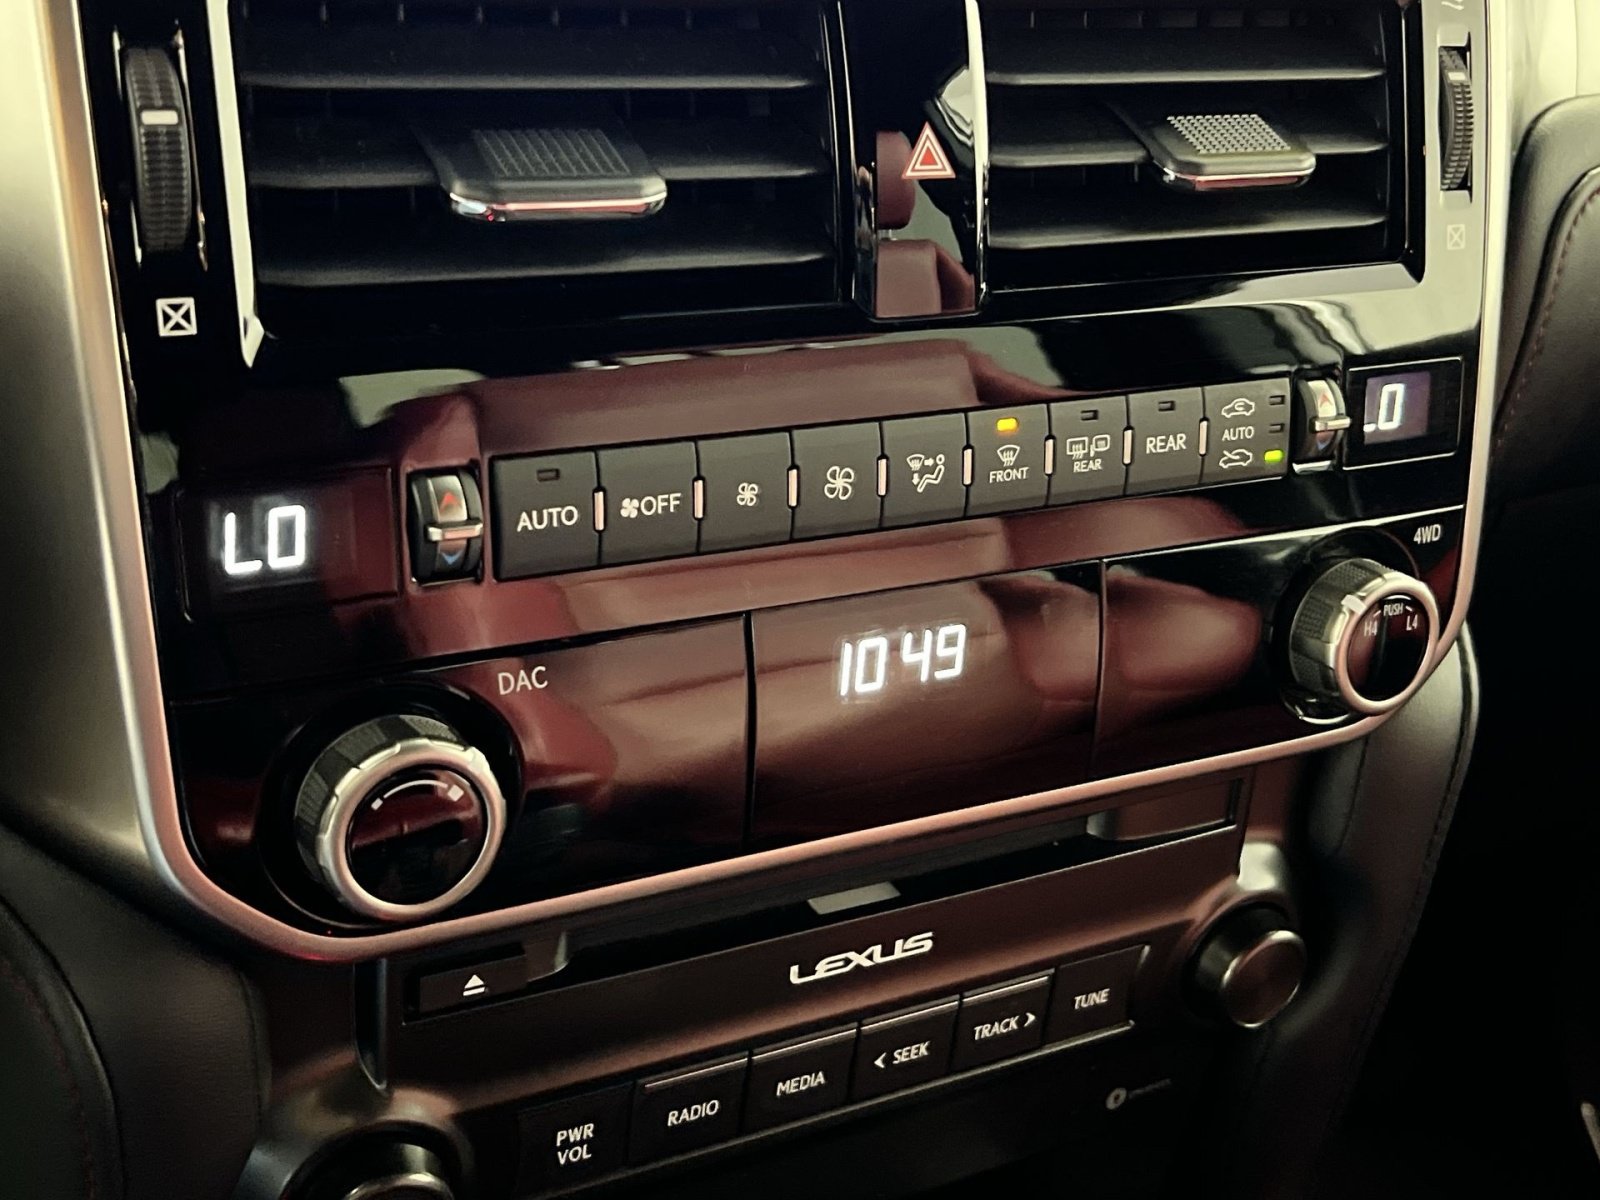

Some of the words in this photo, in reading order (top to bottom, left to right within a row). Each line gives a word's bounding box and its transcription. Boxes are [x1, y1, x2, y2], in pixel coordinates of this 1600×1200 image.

[1145, 434, 1187, 454] REAR
[1221, 426, 1255, 441] AUTO
[989, 466, 1029, 484] FRONT
[1073, 458, 1103, 473] REAR
[640, 492, 682, 516] OFF
[517, 506, 578, 532] AUTO
[222, 504, 307, 576] LO
[1413, 524, 1442, 544] 4WD
[1383, 602, 1404, 617] PUSH
[1363, 620, 1378, 636] H4
[1406, 614, 1418, 631] L4
[497, 665, 549, 695] DAC
[790, 932, 934, 985] LEXUS
[1074, 989, 1110, 1009] TUNE
[973, 1015, 1019, 1040] TRACK
[892, 1040, 930, 1064] SEEK
[776, 1071, 825, 1097] MEDIA
[667, 1100, 720, 1126] RADIO
[556, 1123, 595, 1146] PWR
[557, 1145, 592, 1165] VOL
